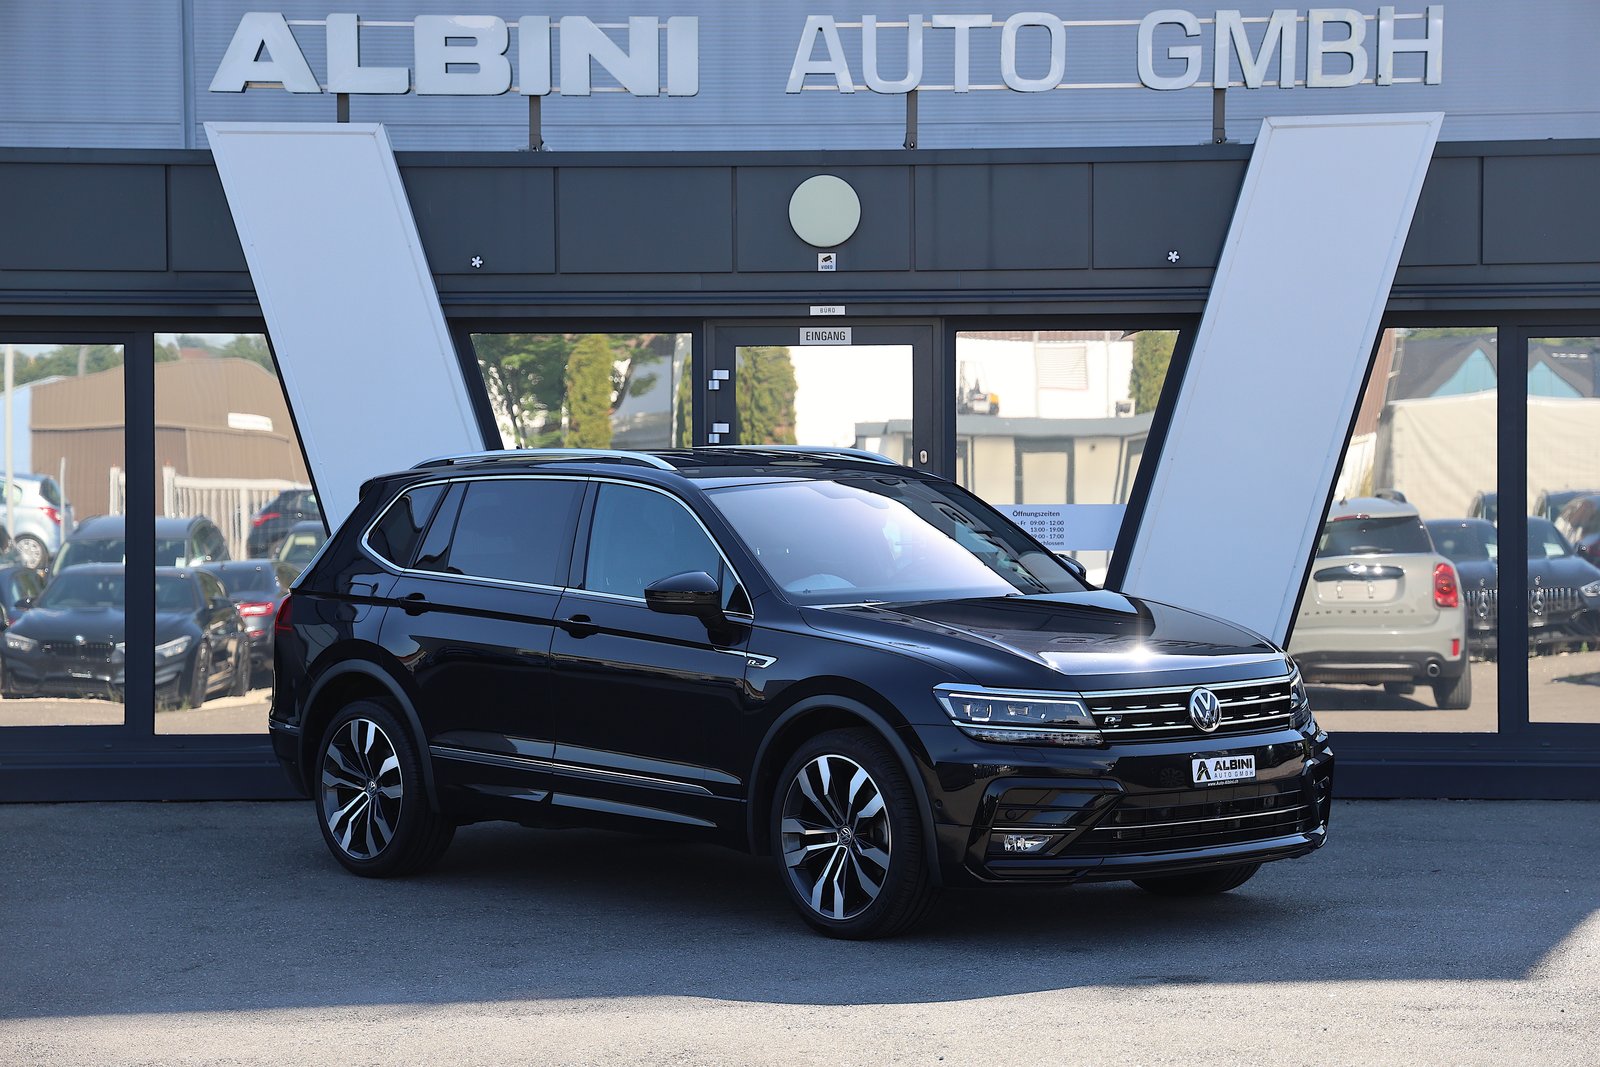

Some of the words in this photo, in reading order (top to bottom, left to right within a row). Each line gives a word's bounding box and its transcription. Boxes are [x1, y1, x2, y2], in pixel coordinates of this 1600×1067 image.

[209, 12, 699, 97] ALBINI
[786, 12, 1066, 94] AUTO
[1137, 5, 1444, 90] GMBH
[805, 331, 846, 341] EINGANG
[1012, 510, 1060, 518] Öffnungszeiten
[1214, 758, 1253, 771] ALBINI
[1213, 771, 1232, 779] AUTO
[1234, 770, 1254, 778] GMBH
